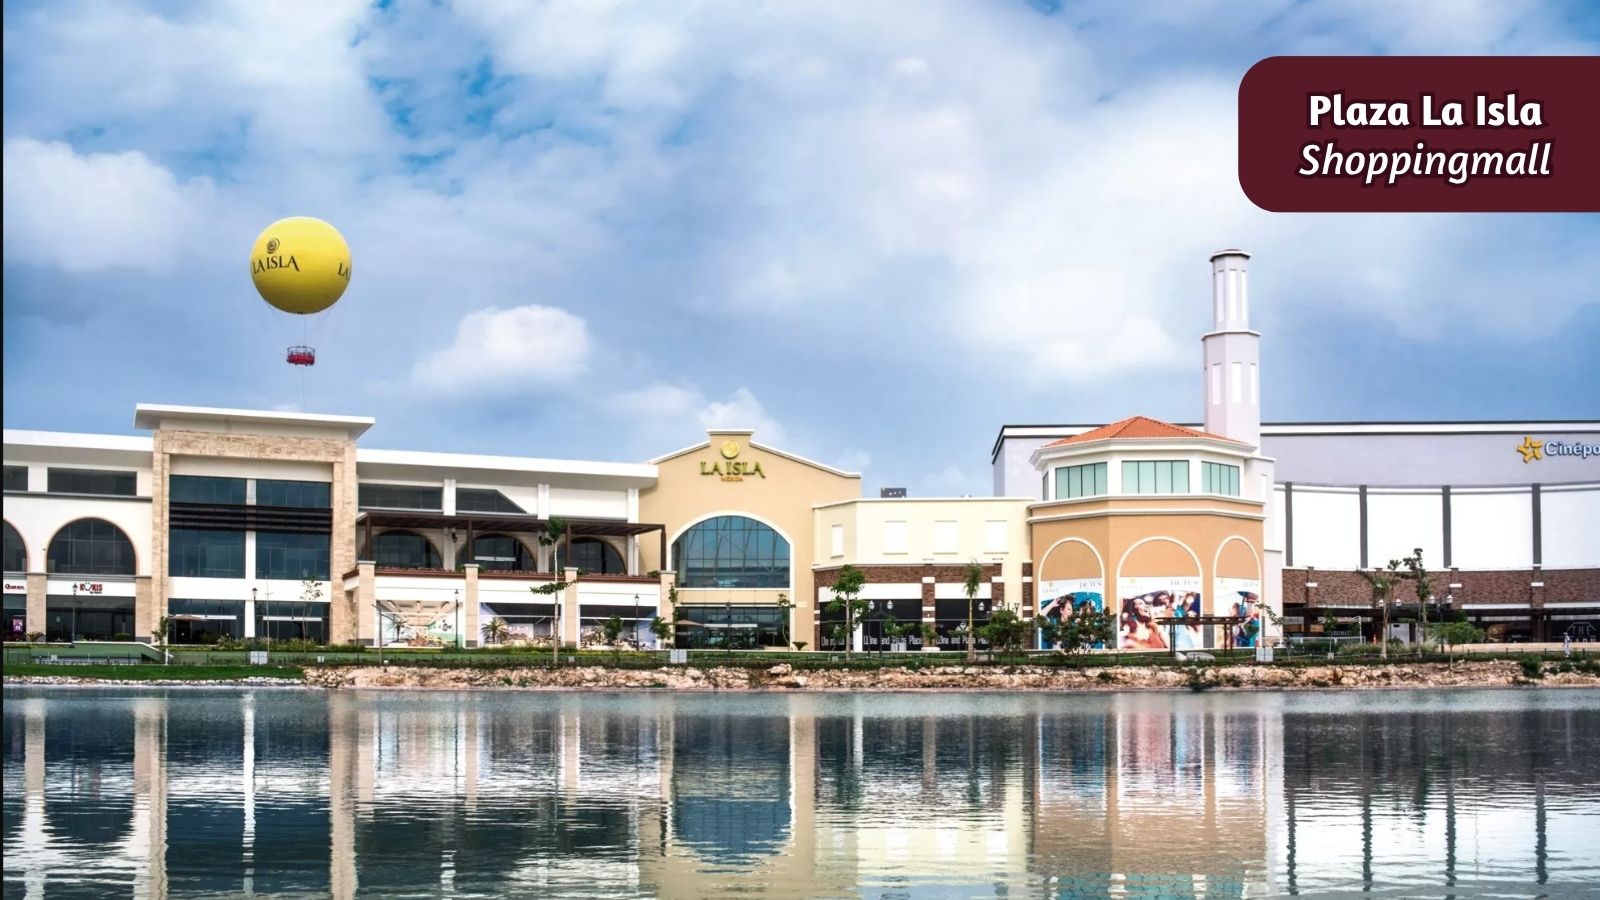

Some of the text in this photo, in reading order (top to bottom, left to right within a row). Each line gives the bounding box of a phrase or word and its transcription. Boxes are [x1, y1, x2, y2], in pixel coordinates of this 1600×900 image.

[252, 255, 300, 274] LA ISLA
[700, 461, 766, 479] LA ISLA
